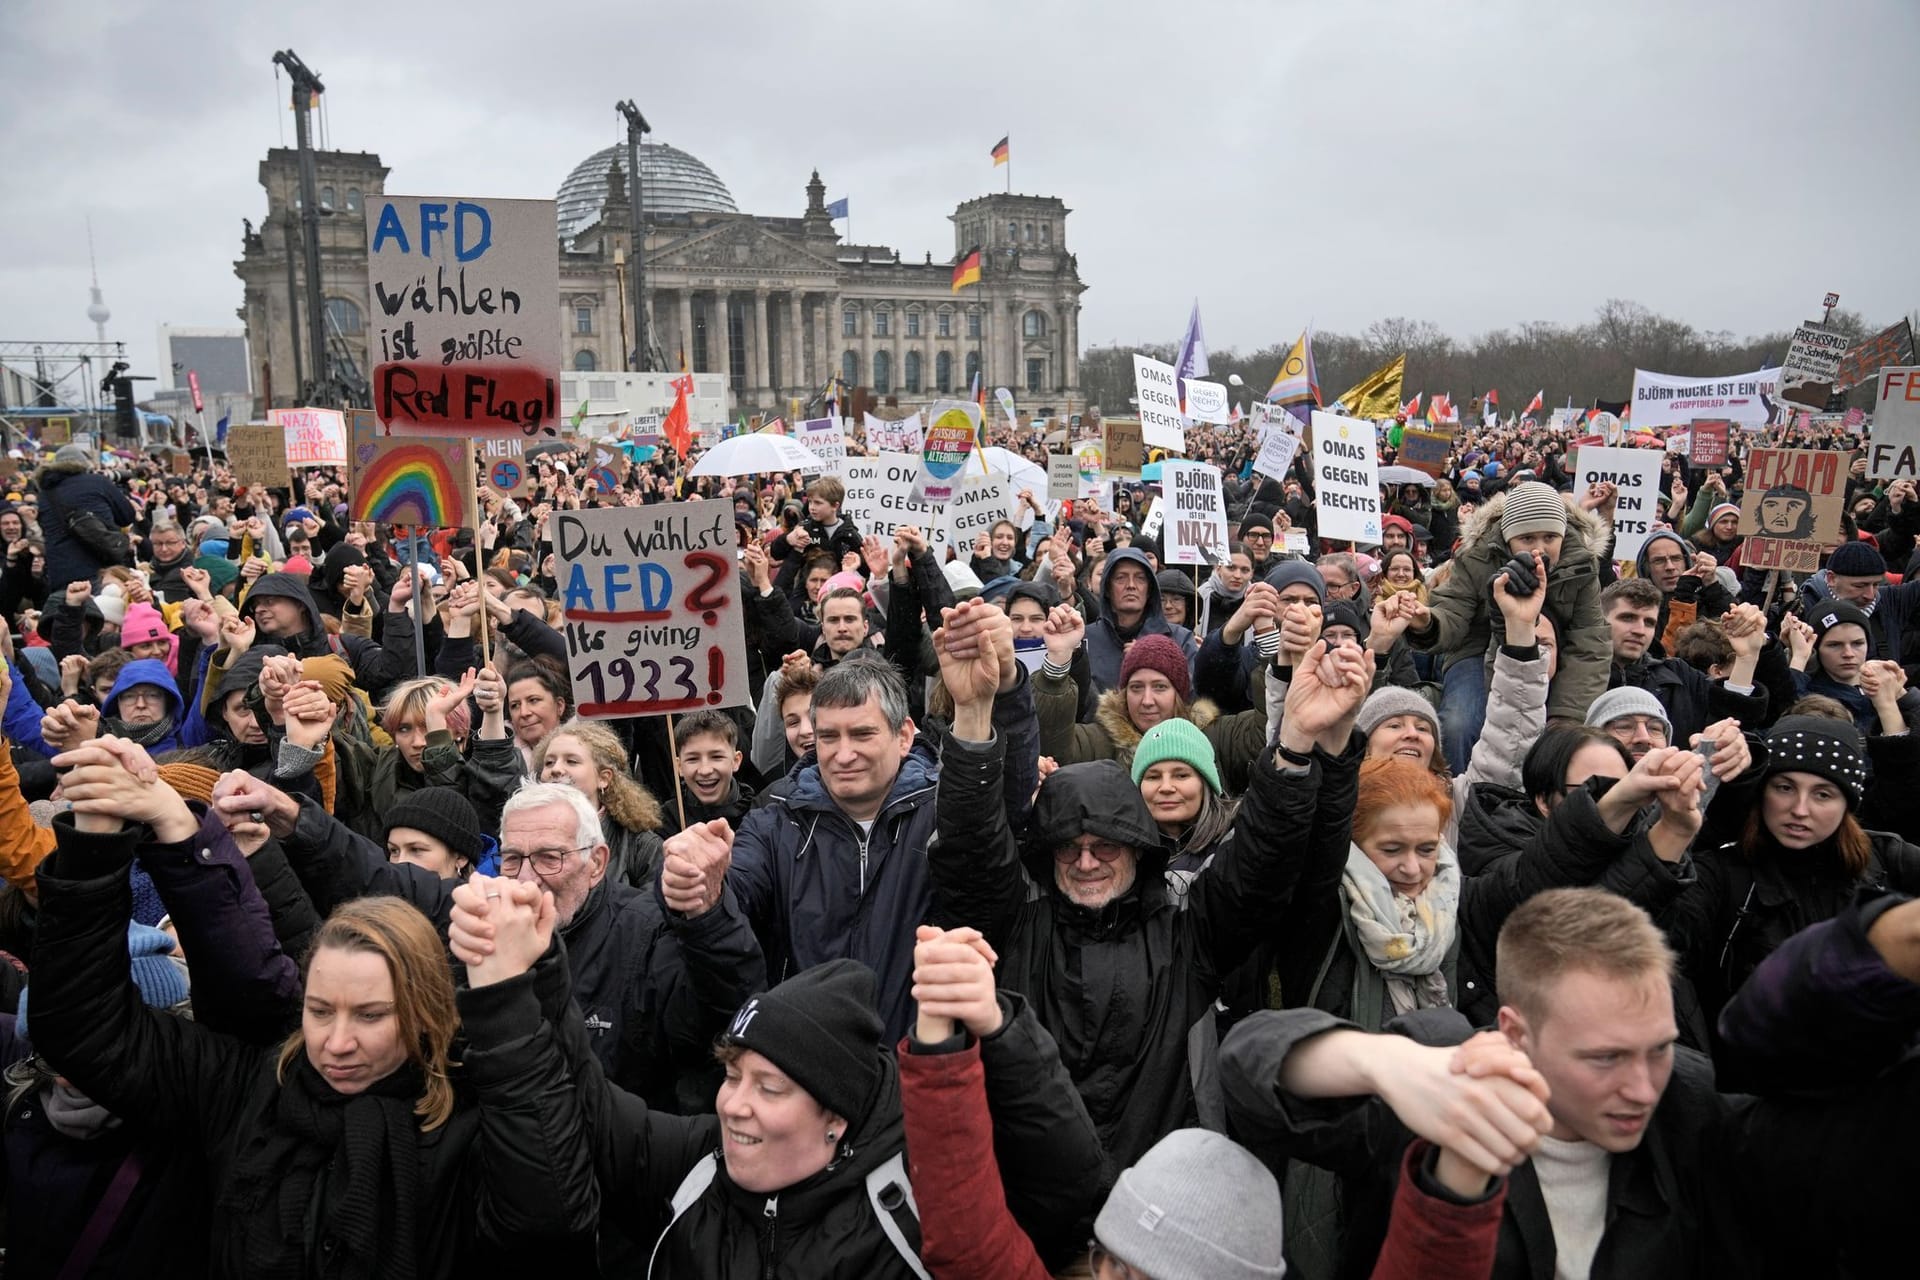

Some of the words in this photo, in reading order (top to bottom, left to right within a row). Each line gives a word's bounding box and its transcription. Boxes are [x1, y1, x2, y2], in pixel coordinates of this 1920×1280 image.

[375, 265, 521, 316] wählen
[381, 321, 421, 361] ist
[441, 328, 522, 366] größte
[1141, 367, 1172, 386] OMAS
[384, 366, 449, 422] Red
[465, 373, 556, 437] Flag!
[1142, 388, 1177, 408] GEGEN
[1193, 387, 1219, 397] GEGEN
[1193, 395, 1220, 407] RECHTS
[1638, 385, 1674, 401] BJÖRN
[1717, 382, 1735, 395] IST
[1739, 383, 1757, 395] EIN
[282, 413, 320, 428] NAZIS
[1143, 410, 1181, 430] RECHTS
[288, 440, 338, 461] HARAM
[487, 439, 522, 458] NEIN
[801, 433, 840, 447] OMAS
[1268, 442, 1289, 454] GEGEN
[1323, 440, 1366, 461] OMAS
[1175, 468, 1216, 491] BJÖRN
[1322, 465, 1369, 487] GEGEN
[1586, 471, 1642, 487] OMAS
[880, 494, 944, 515] GEGEN
[1176, 489, 1217, 512] HÖCKE
[1322, 491, 1376, 513] RECHTS
[955, 508, 1009, 529] GEGEN
[1198, 512, 1206, 520] EIN
[559, 516, 612, 561] Du
[874, 521, 945, 543] RETS
[1177, 520, 1218, 547] NAZI
[566, 621, 606, 658] Its
[624, 625, 701, 657] giving
